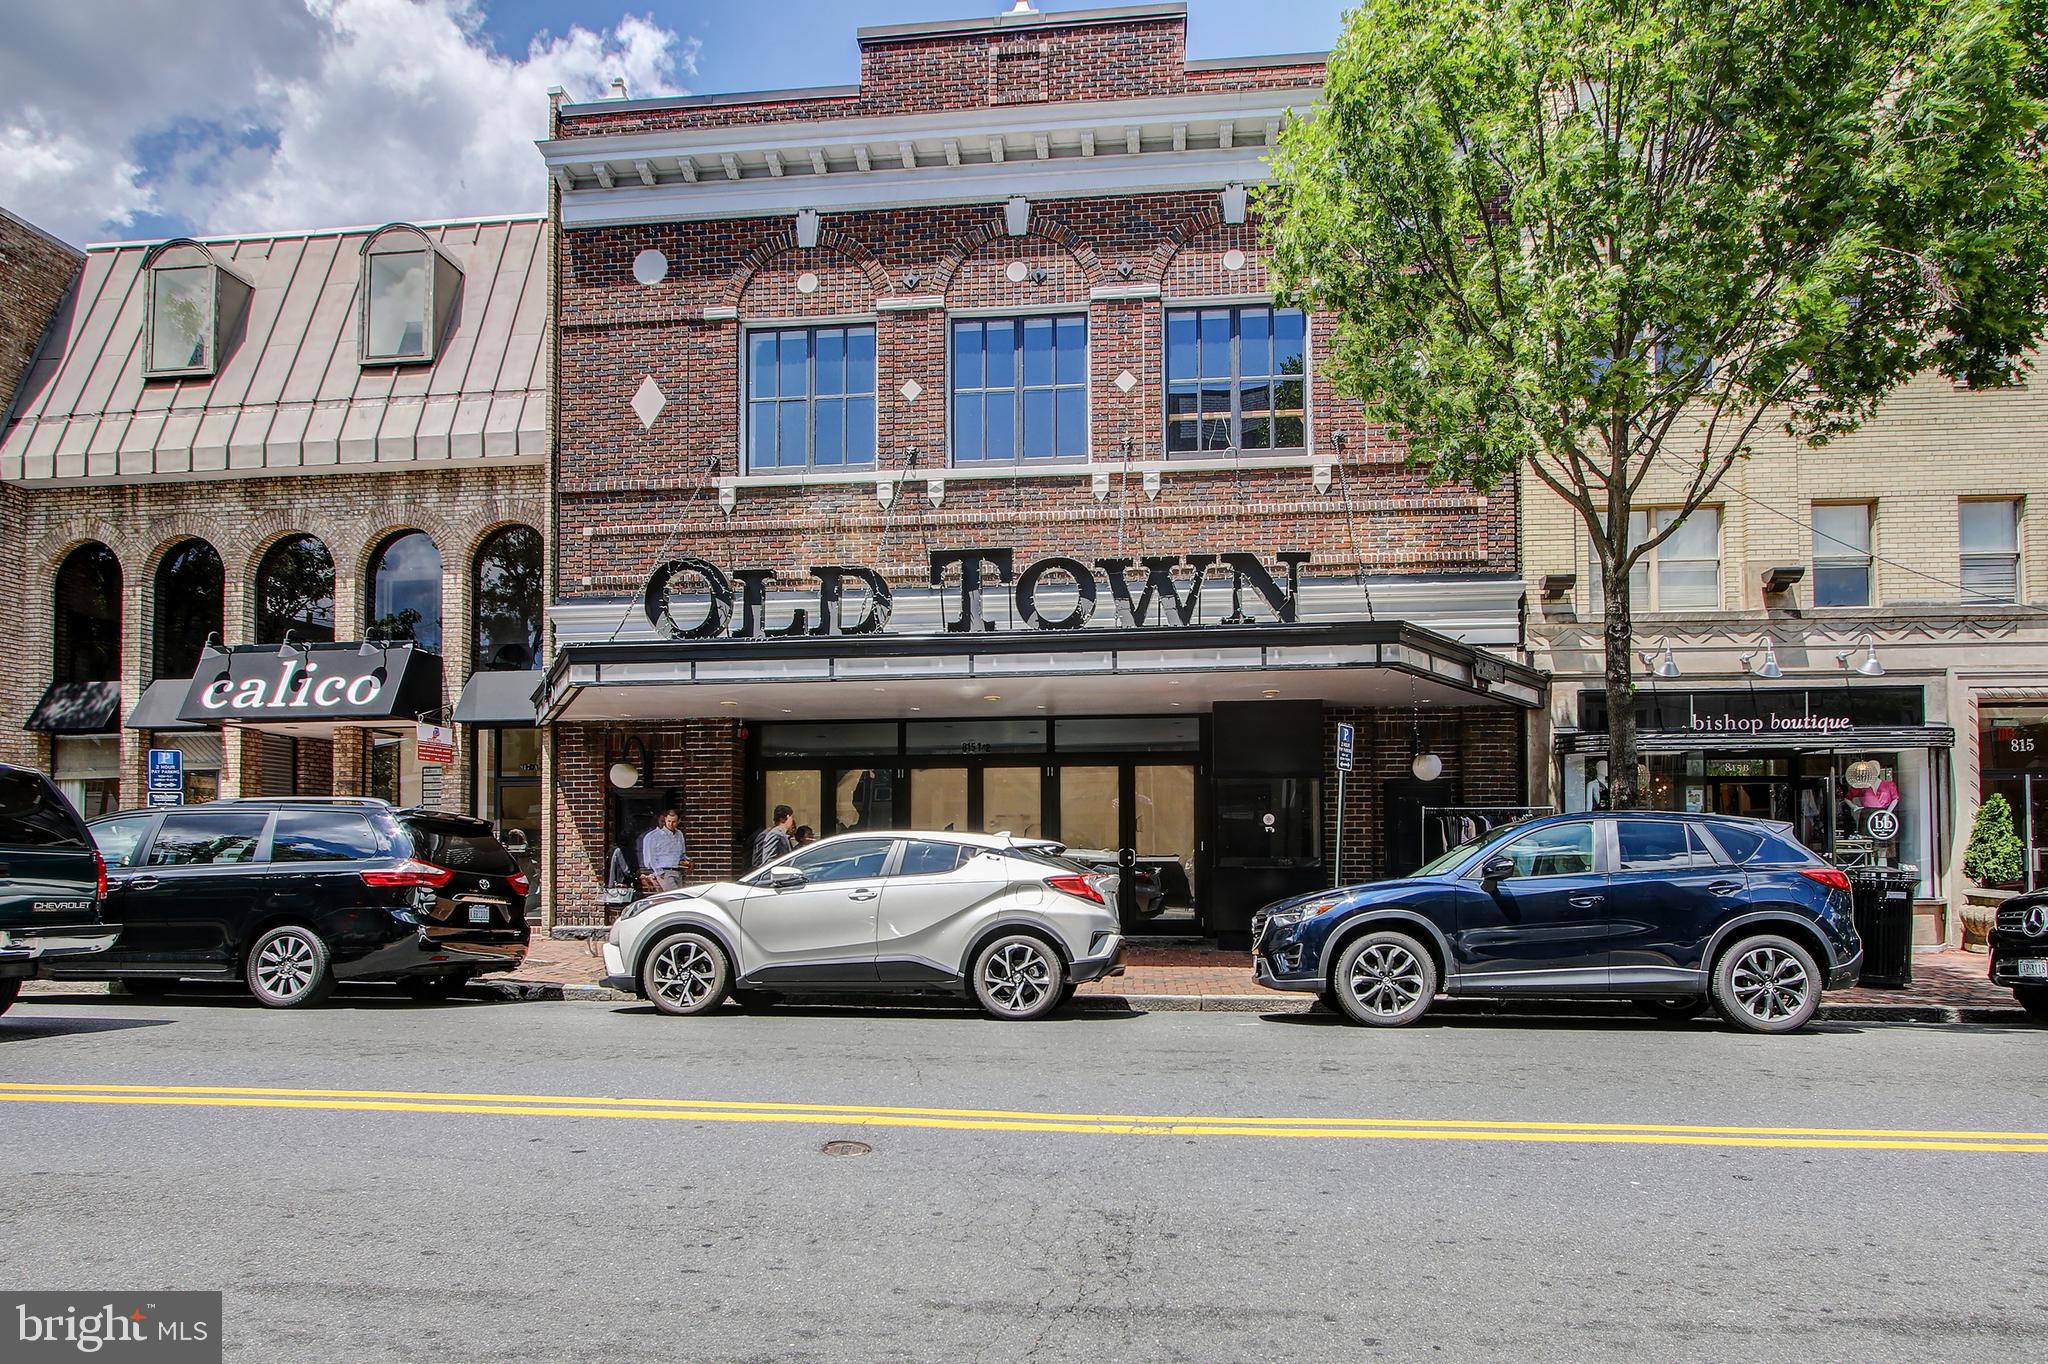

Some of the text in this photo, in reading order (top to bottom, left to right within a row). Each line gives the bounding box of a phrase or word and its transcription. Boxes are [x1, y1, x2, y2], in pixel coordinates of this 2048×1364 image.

[644, 548, 1312, 640] OLD TOWN
[202, 659, 382, 709] calico
[1692, 713, 1851, 735] bishop boutique
[2010, 738, 2035, 752] 815
[1874, 815, 1893, 829] bb
[33, 901, 91, 909] CHEVROLET
